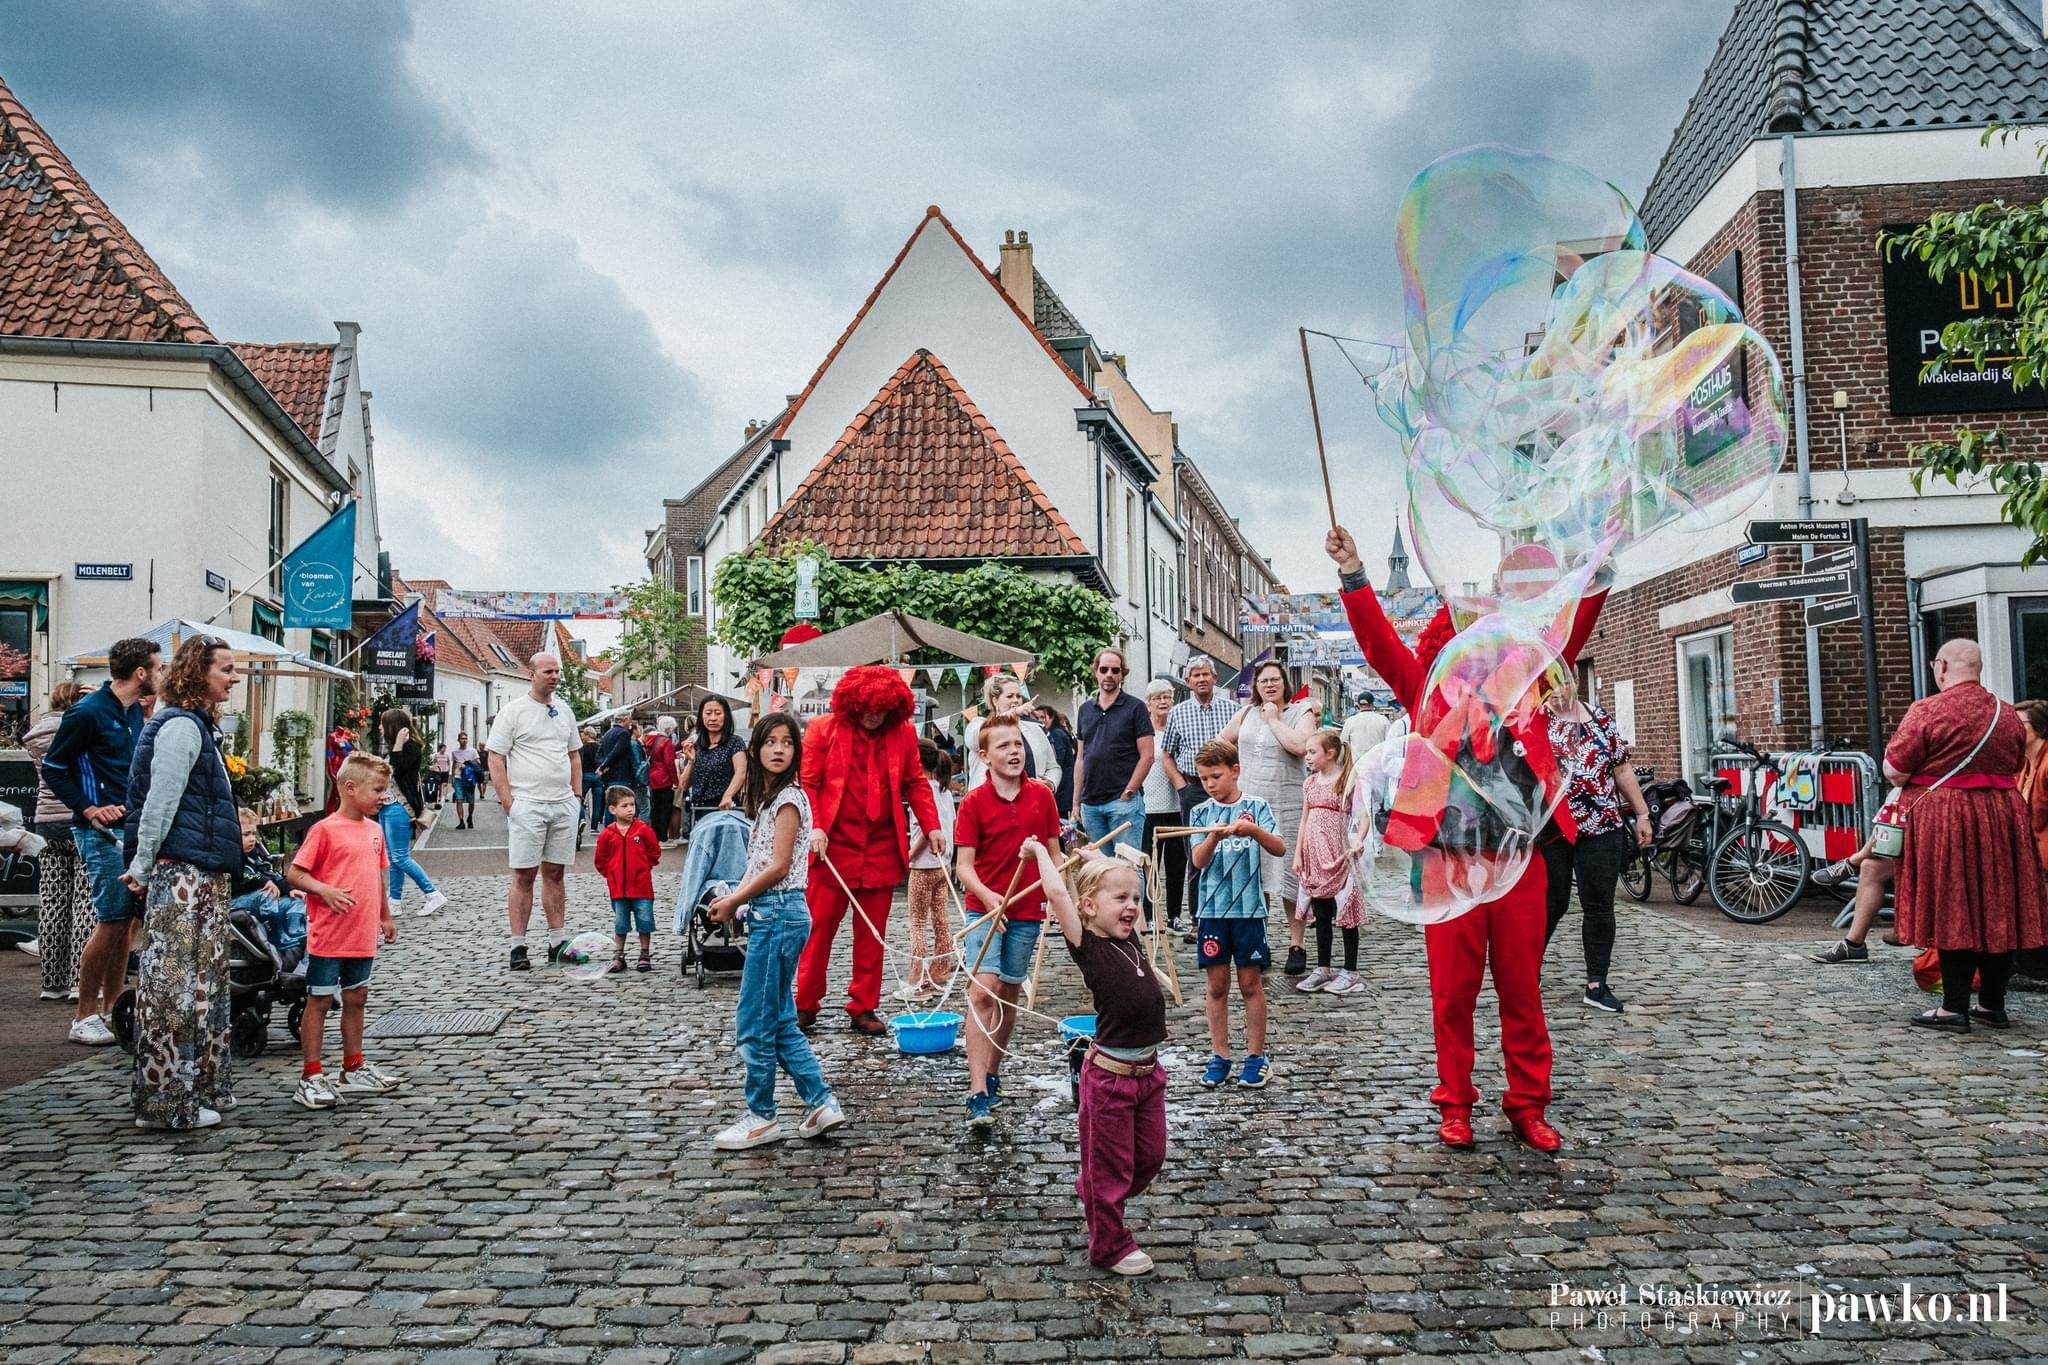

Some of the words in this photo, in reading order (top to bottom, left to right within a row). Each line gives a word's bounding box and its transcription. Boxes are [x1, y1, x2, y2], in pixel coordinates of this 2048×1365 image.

[1922, 369, 1998, 384] Makelaardij
[2001, 367, 2012, 380] &
[1690, 364, 1732, 409] POSTHUIS
[78, 566, 127, 576] MOLENBELT
[1281, 624, 1315, 632] HATTEM
